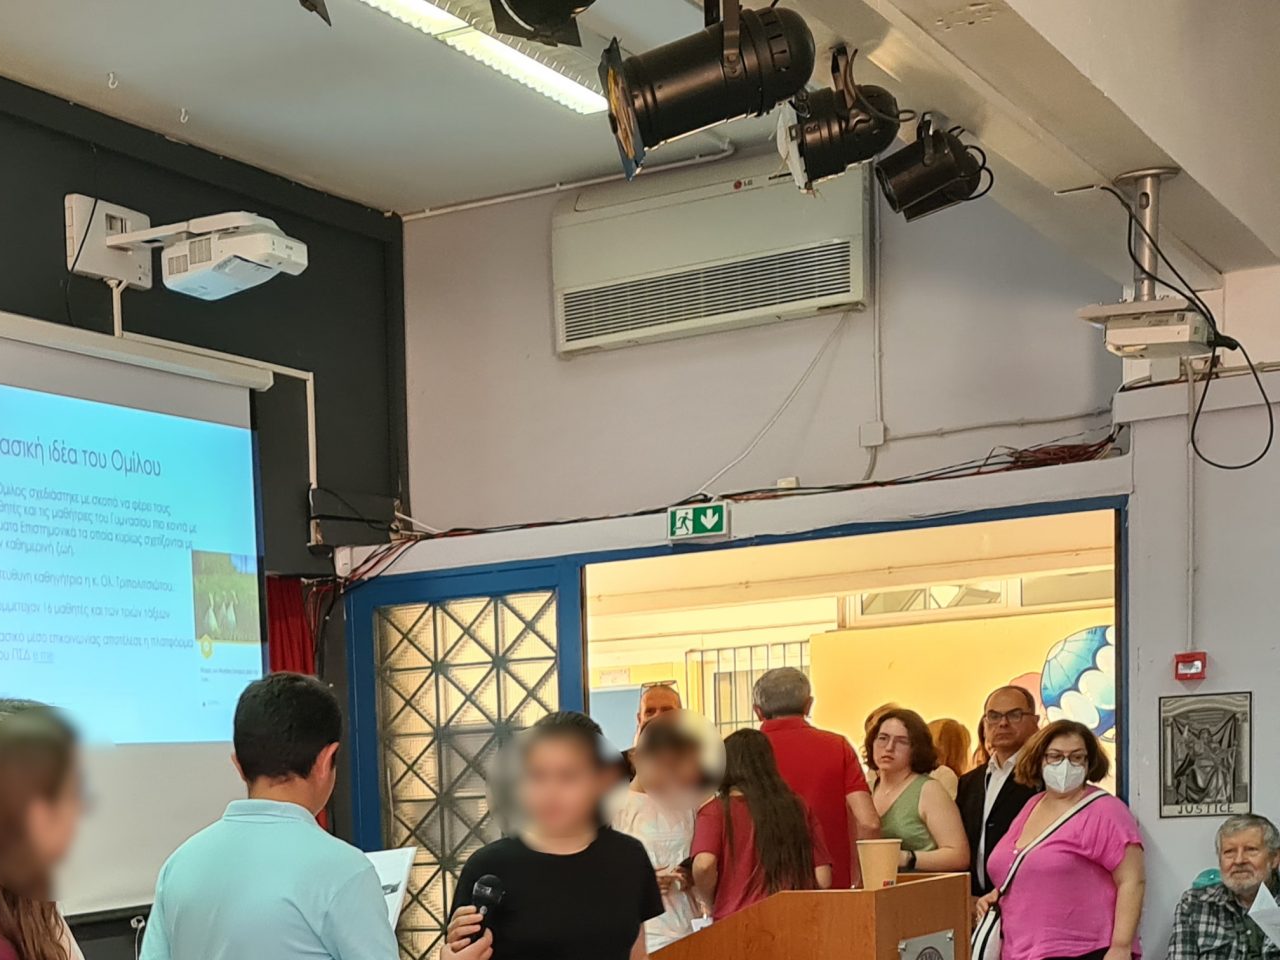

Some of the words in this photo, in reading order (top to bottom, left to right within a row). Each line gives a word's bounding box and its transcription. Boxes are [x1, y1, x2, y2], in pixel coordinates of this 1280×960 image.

[48, 440, 78, 465] ιδέα
[82, 448, 107, 469] του
[111, 449, 162, 478] Ομίλου
[1177, 803, 1235, 815] JUSTICE
